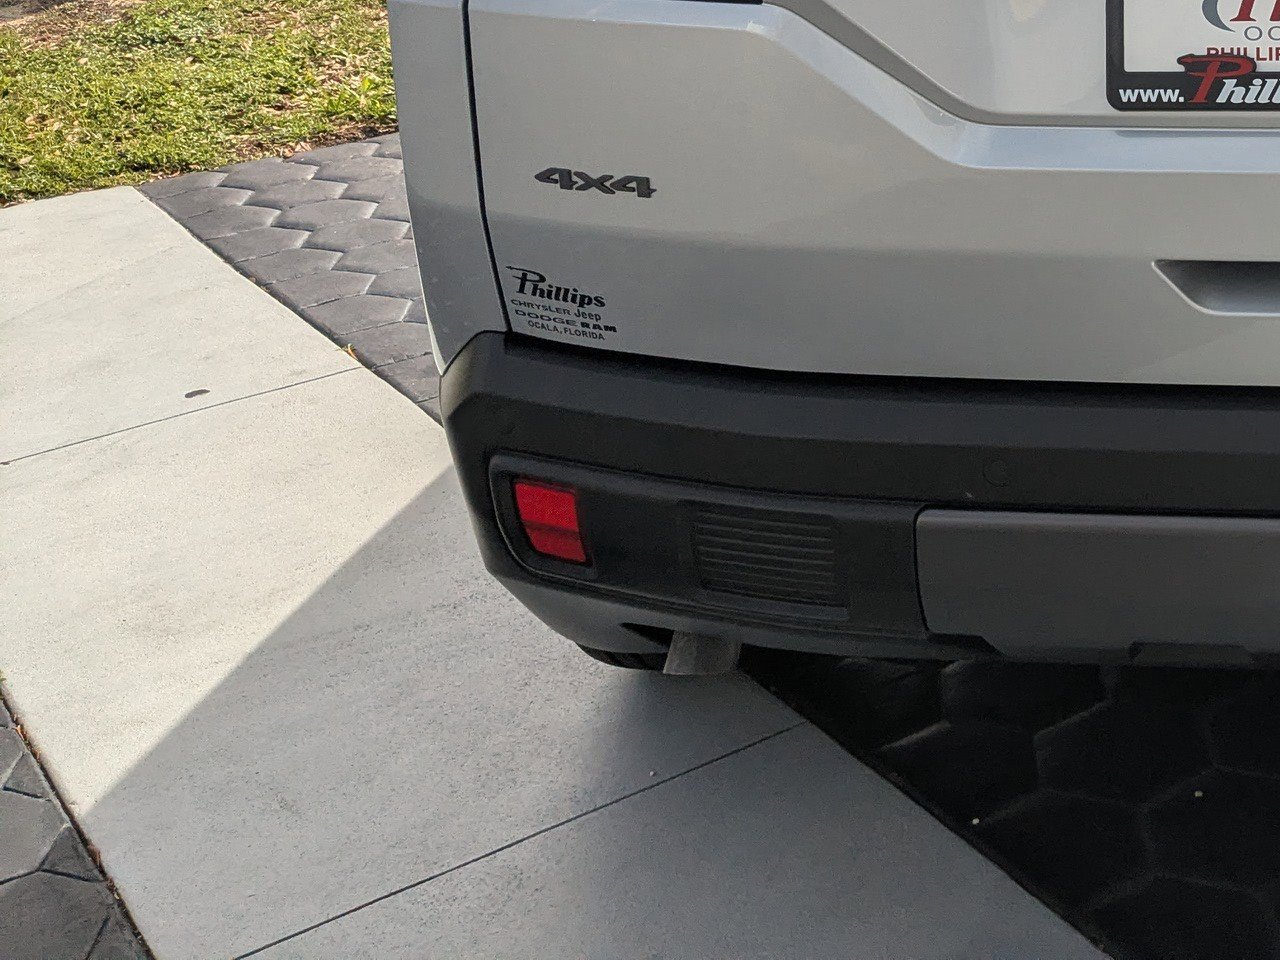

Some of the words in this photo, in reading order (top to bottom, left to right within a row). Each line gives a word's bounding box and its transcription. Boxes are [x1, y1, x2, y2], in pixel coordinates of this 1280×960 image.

[505, 265, 606, 308] Phillips
[511, 299, 571, 316] CHRYSLER
[574, 309, 602, 322] Jeep
[515, 309, 579, 327] DODGE
[580, 321, 617, 333] RAM
[563, 326, 606, 341] FLORIDA
